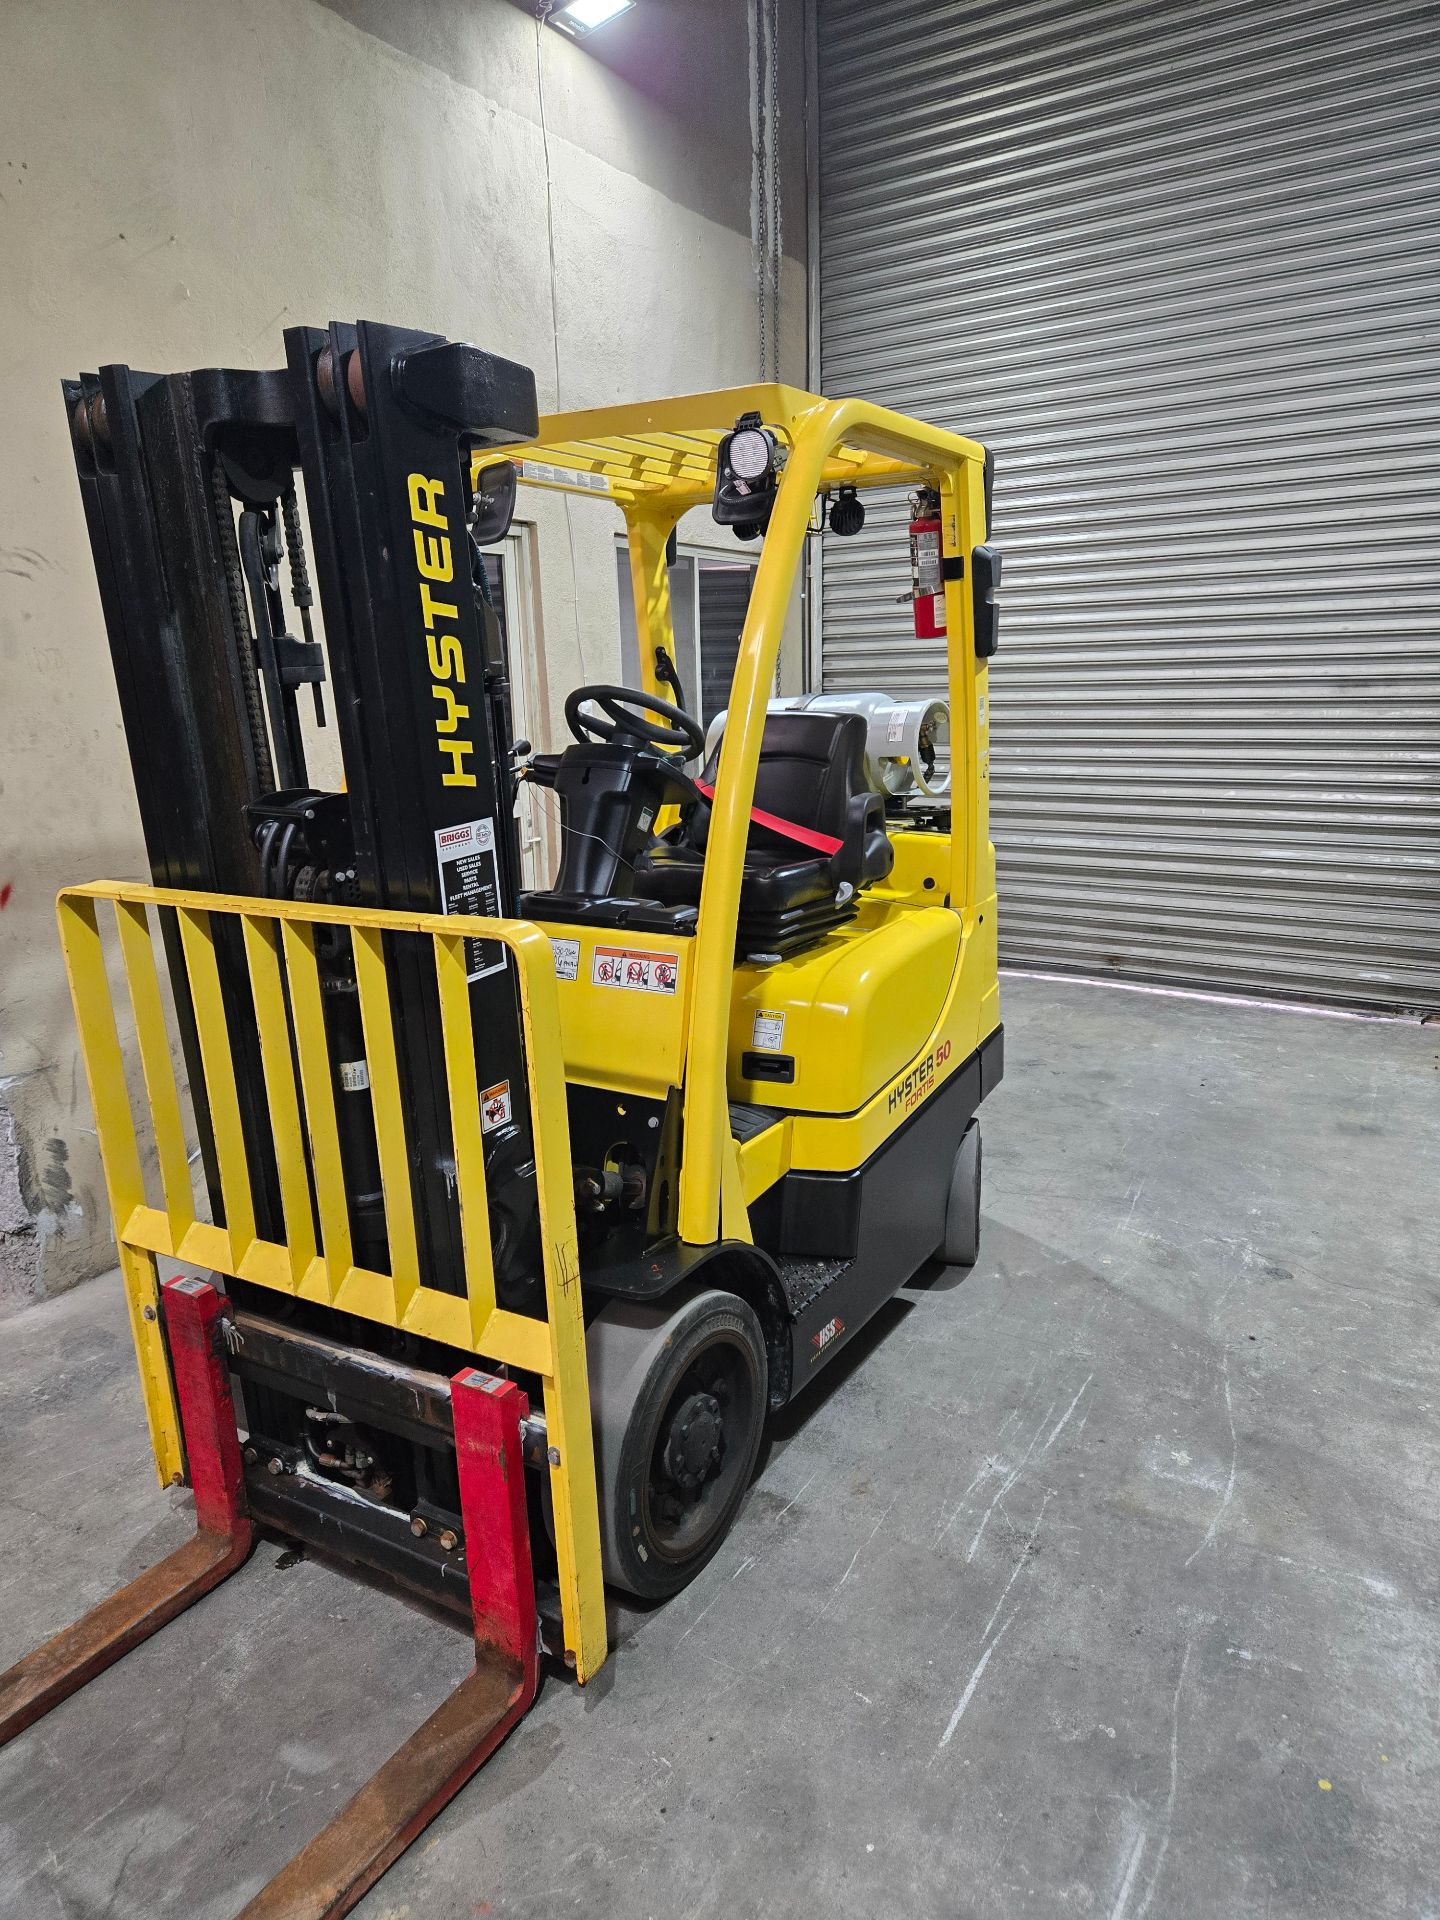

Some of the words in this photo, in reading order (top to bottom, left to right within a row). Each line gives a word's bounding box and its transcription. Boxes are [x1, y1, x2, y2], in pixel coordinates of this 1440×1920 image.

[407, 472, 477, 787] HYSTER
[440, 829, 470, 844] BRIGGS
[888, 1054, 934, 1115] HYSTER
[936, 1039, 951, 1067] 50
[905, 1074, 935, 1112] FORTIS
